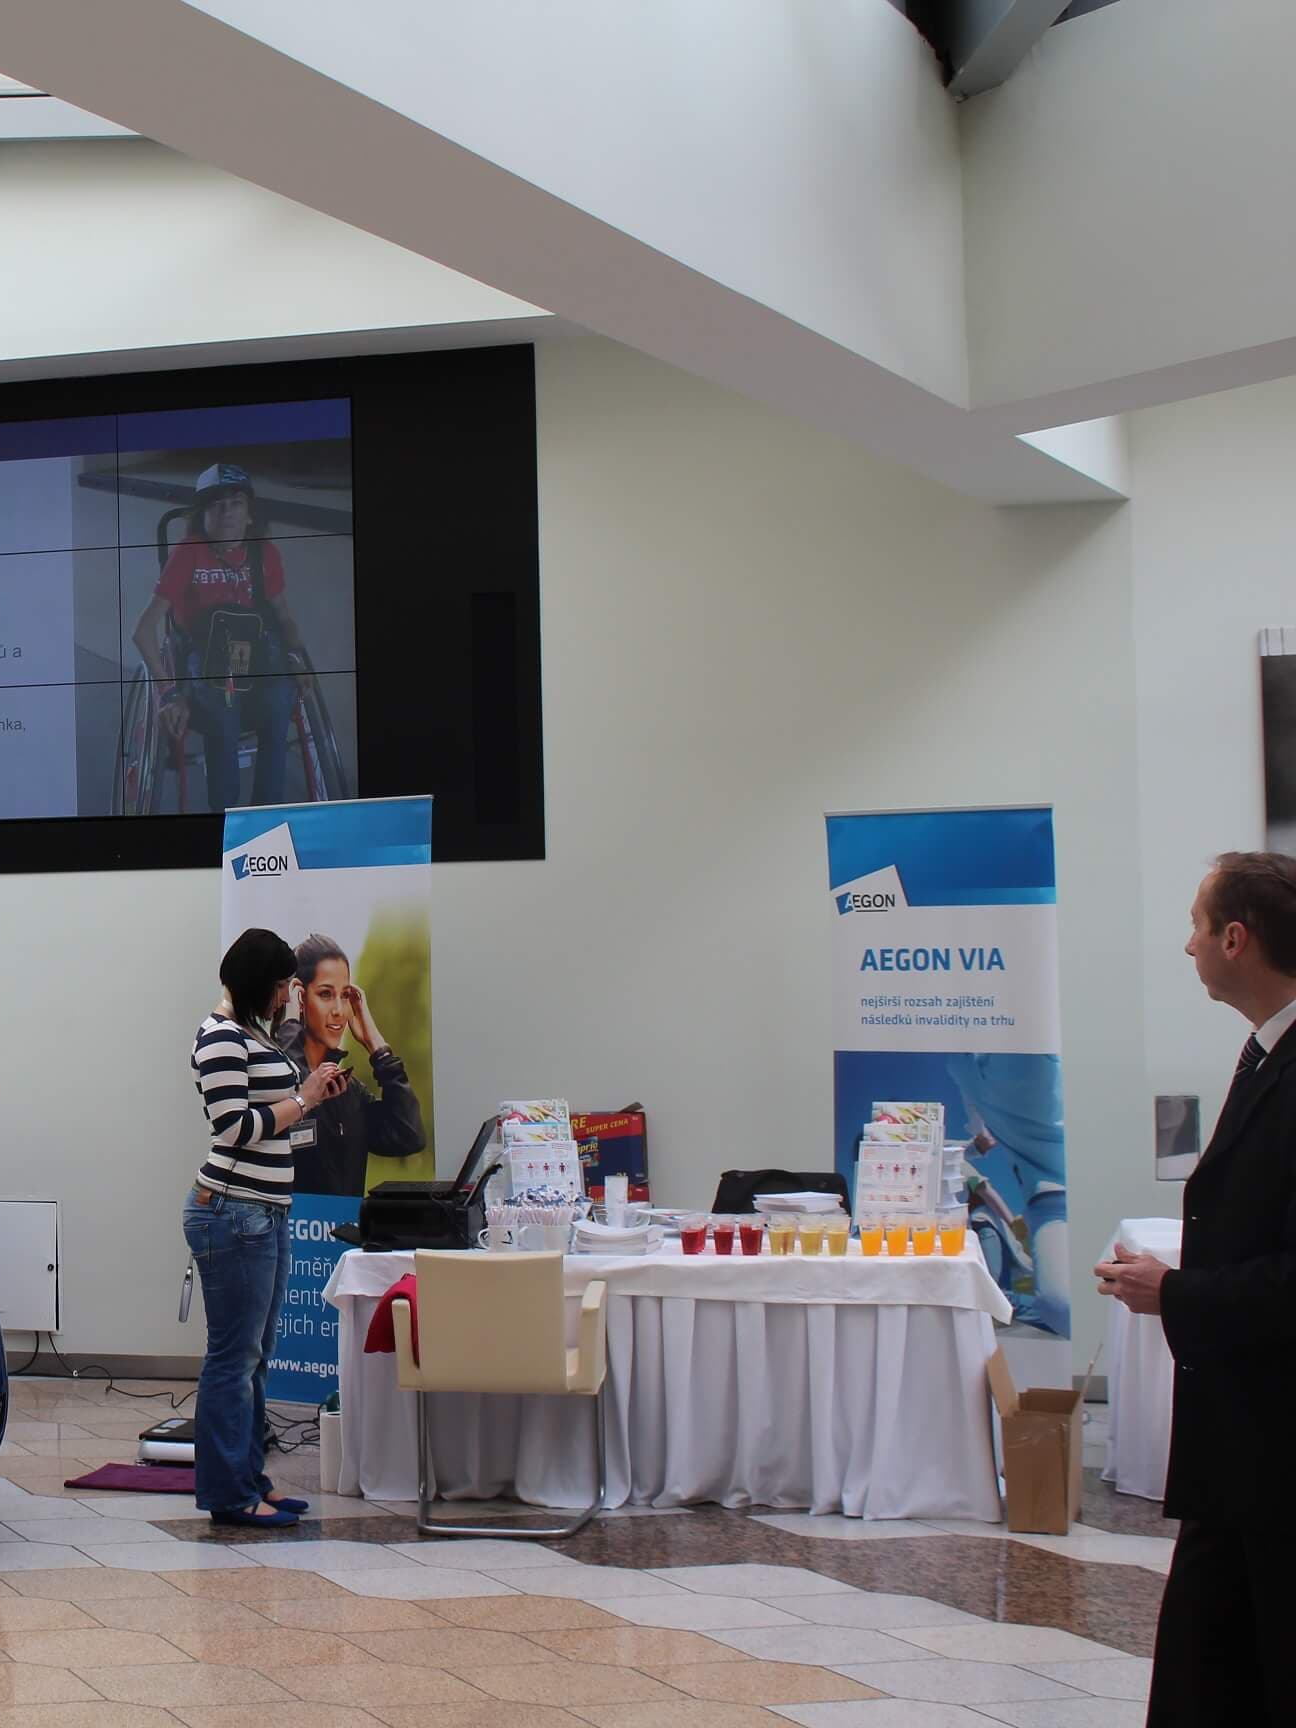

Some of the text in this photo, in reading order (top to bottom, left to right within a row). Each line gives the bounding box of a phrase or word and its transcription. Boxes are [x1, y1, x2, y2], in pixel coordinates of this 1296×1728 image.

[12, 646, 23, 659] a
[241, 855, 288, 873] AEGON
[844, 893, 896, 908] AEGON
[860, 947, 1006, 971] AEGON VIA
[860, 995, 995, 1010] nejširší rozsah zajištění
[861, 1013, 1015, 1029] následků invalidity na trhu
[288, 1218, 336, 1242] EGON
[274, 1312, 314, 1338] ejich
[267, 1358, 340, 1378] www.aego
